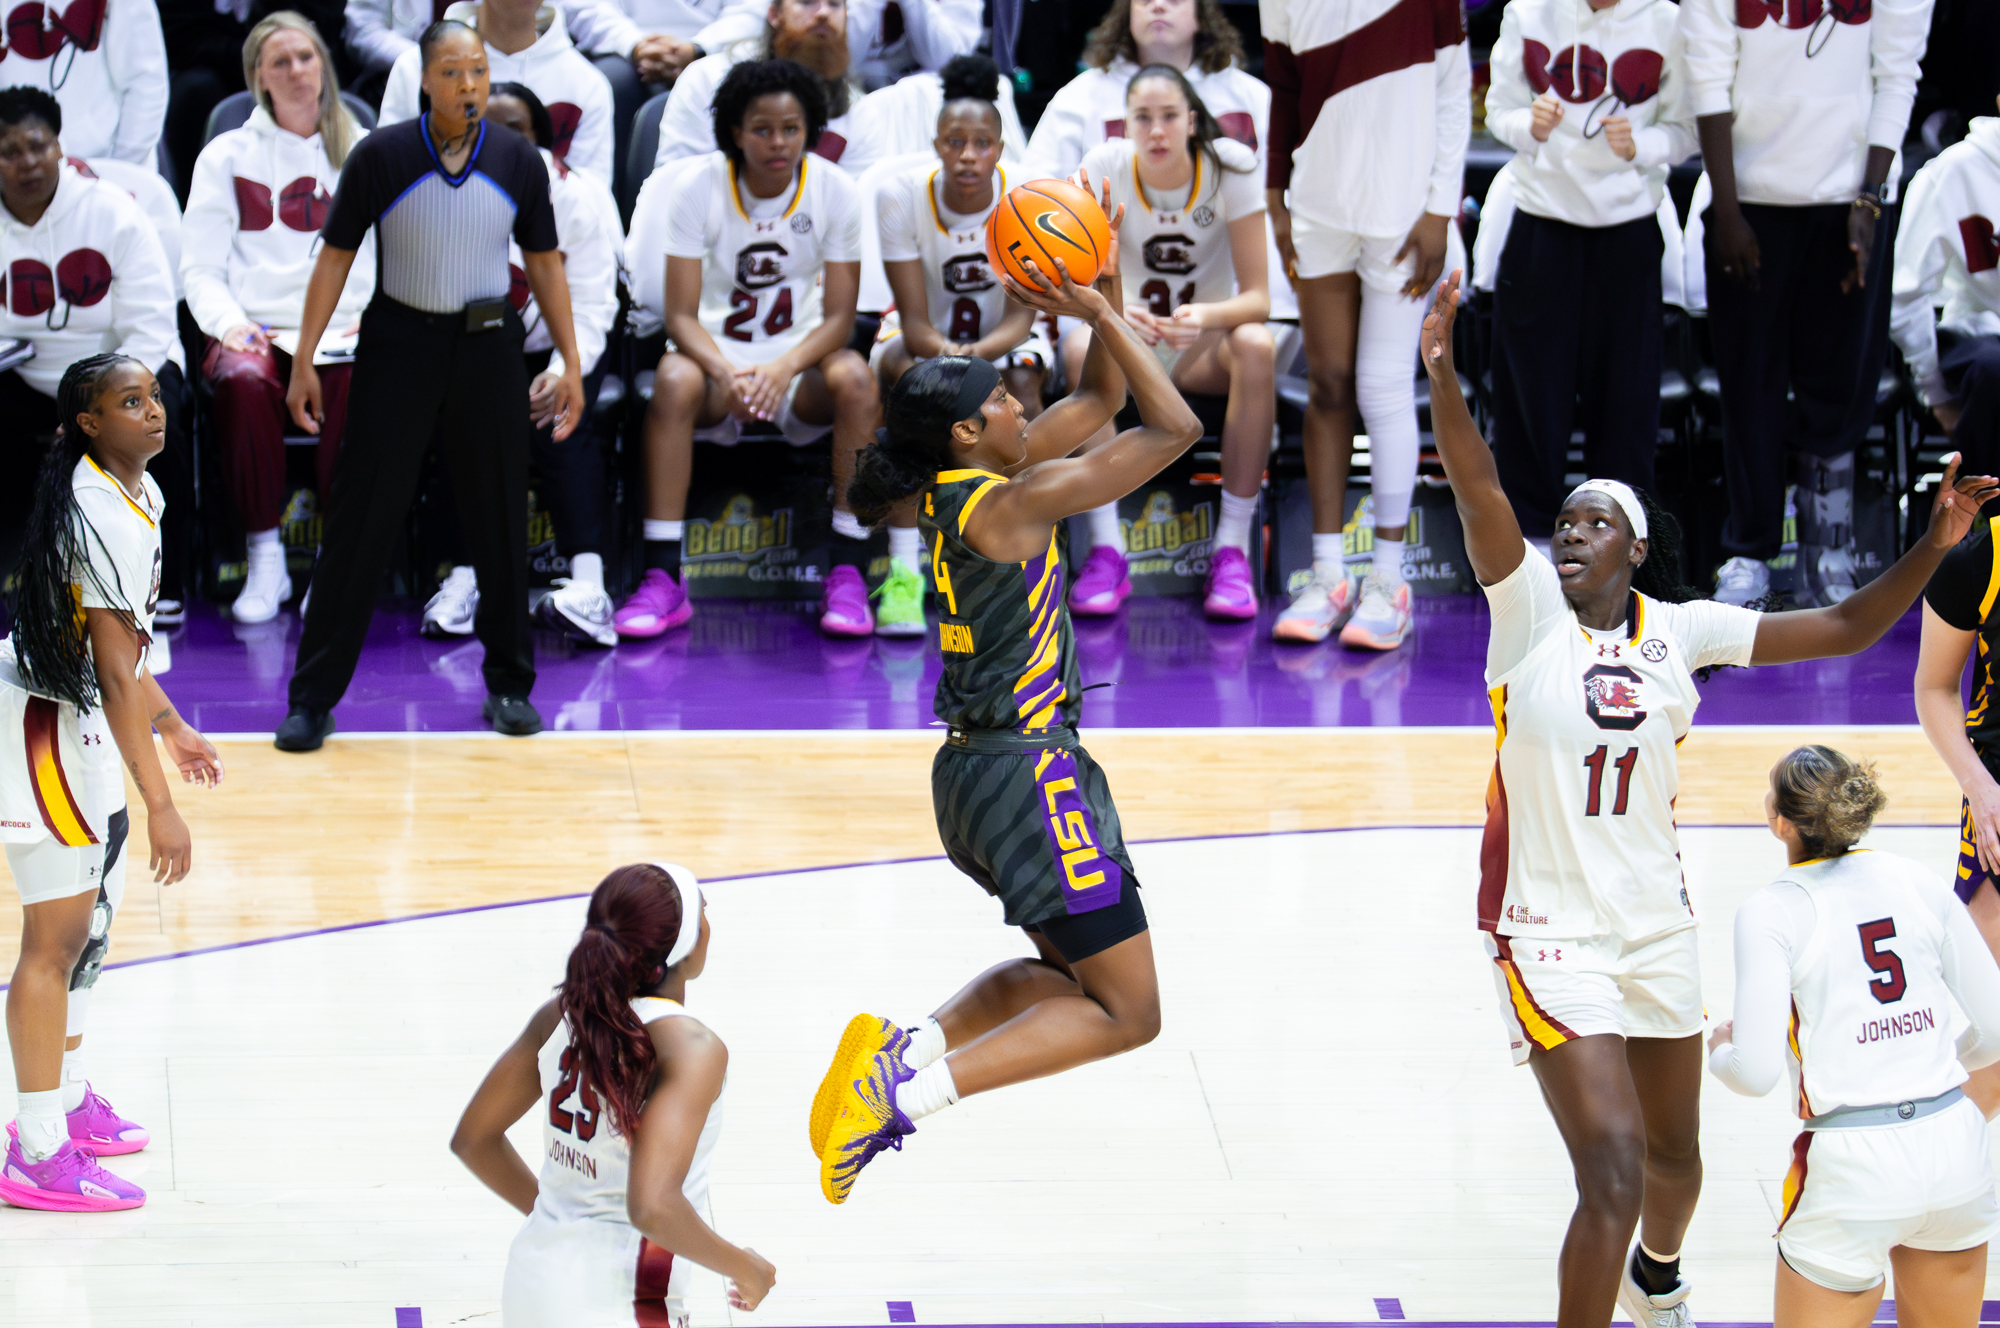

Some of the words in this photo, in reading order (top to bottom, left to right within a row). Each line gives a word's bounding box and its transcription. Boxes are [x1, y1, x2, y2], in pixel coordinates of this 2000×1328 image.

[723, 286, 794, 343] 24
[933, 529, 957, 615] 4
[1401, 563, 1456, 580] O.N.E.
[1641, 638, 1668, 663] SEC
[1583, 744, 1639, 817] 11
[1043, 776, 1106, 891] LSU
[1515, 914, 1548, 925] CULTURE
[1517, 905, 1529, 915] THE
[1857, 915, 1908, 1005] 5
[1856, 1007, 1935, 1045] JOHNSON
[549, 1138, 597, 1180] JOHNSON
